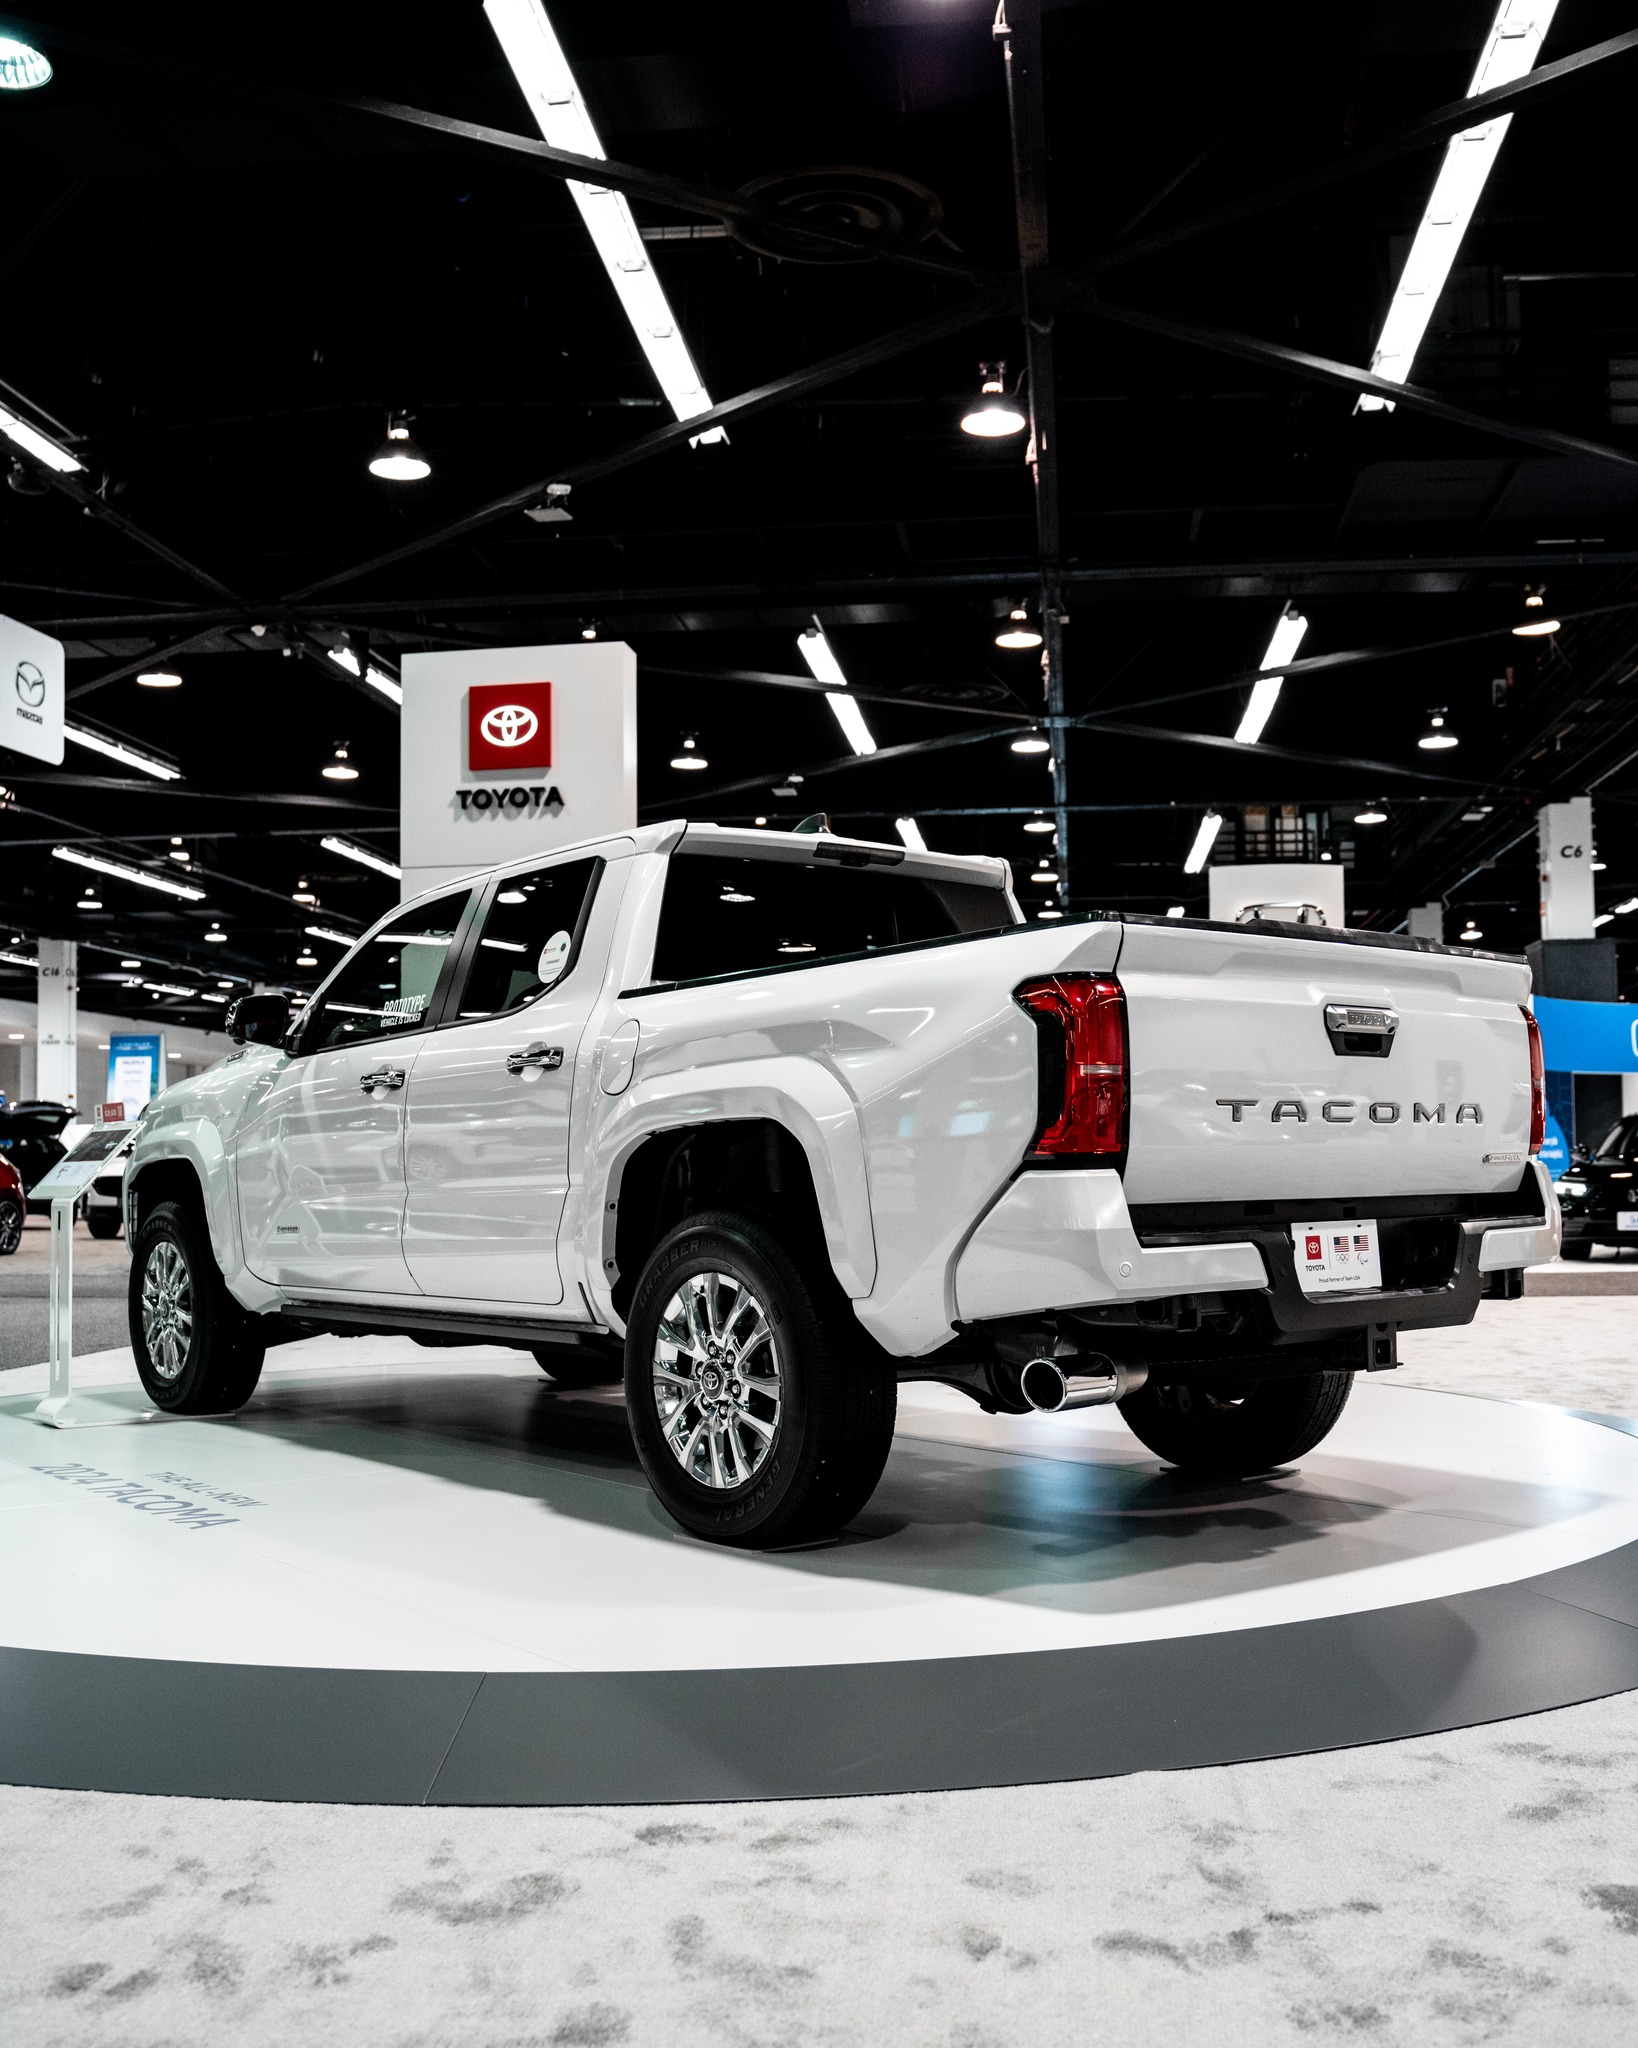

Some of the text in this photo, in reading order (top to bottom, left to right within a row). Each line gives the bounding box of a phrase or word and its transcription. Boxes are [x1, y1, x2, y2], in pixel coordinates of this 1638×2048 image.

[455, 786, 565, 810] TOYOTA
[1560, 845, 1583, 859] C6
[382, 994, 427, 1018] PROTOTYPE
[380, 1012, 422, 1028] VEHICLE IS LOCKED
[1215, 1100, 1484, 1125] TACOMA
[638, 1239, 700, 1309] GRABBER
[29, 1463, 241, 1530] 2024 TACOMA
[145, 1471, 269, 1507] THE ALL-NEW
[715, 1458, 781, 1522] GENERAL
